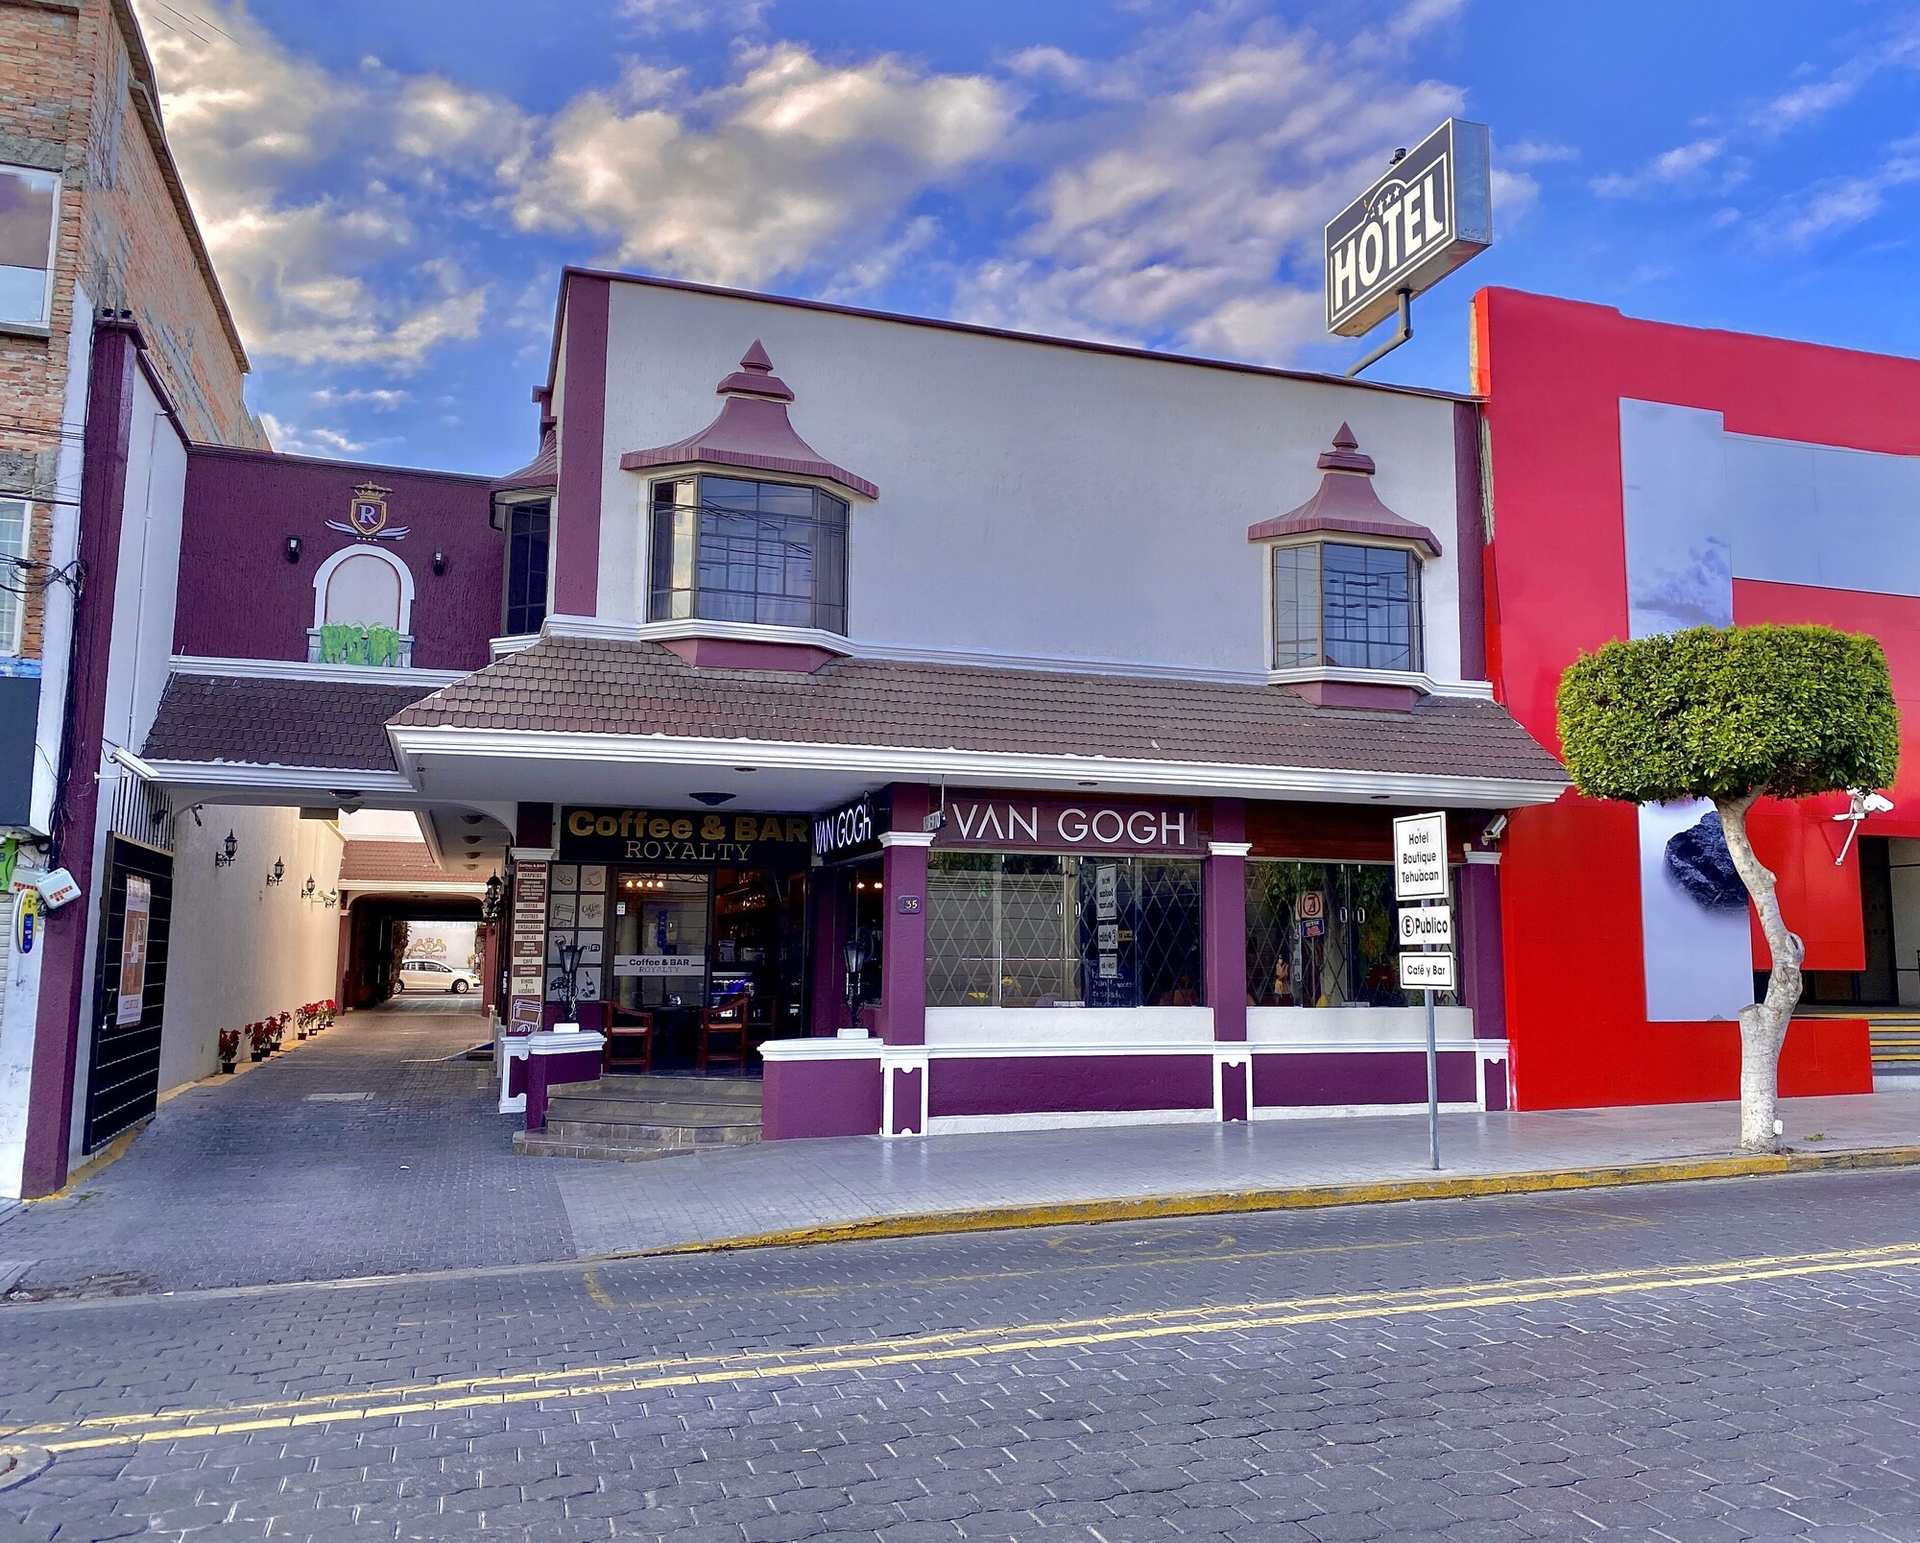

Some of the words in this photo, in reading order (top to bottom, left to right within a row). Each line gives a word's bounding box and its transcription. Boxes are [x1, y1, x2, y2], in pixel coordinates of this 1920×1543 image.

[1334, 173, 1443, 311] HOTEL
[358, 504, 378, 525] R
[568, 810, 693, 839] Coffee
[700, 815, 726, 840] &
[734, 817, 808, 842] BAR
[952, 803, 1038, 842] VAN
[1057, 808, 1185, 845] GOGH
[815, 816, 834, 854] VAN
[1408, 832, 1429, 845] Hotel
[625, 840, 751, 861] ROYALTY
[1402, 851, 1437, 865] Boutique
[1401, 871, 1439, 883] Tehuacan
[1415, 917, 1448, 934] Publico
[629, 958, 660, 966] Coffee
[661, 958, 669, 966] &
[670, 958, 690, 966] BAR
[1407, 964, 1425, 975] Café
[1426, 967, 1431, 978] y
[1432, 964, 1446, 975] Bar
